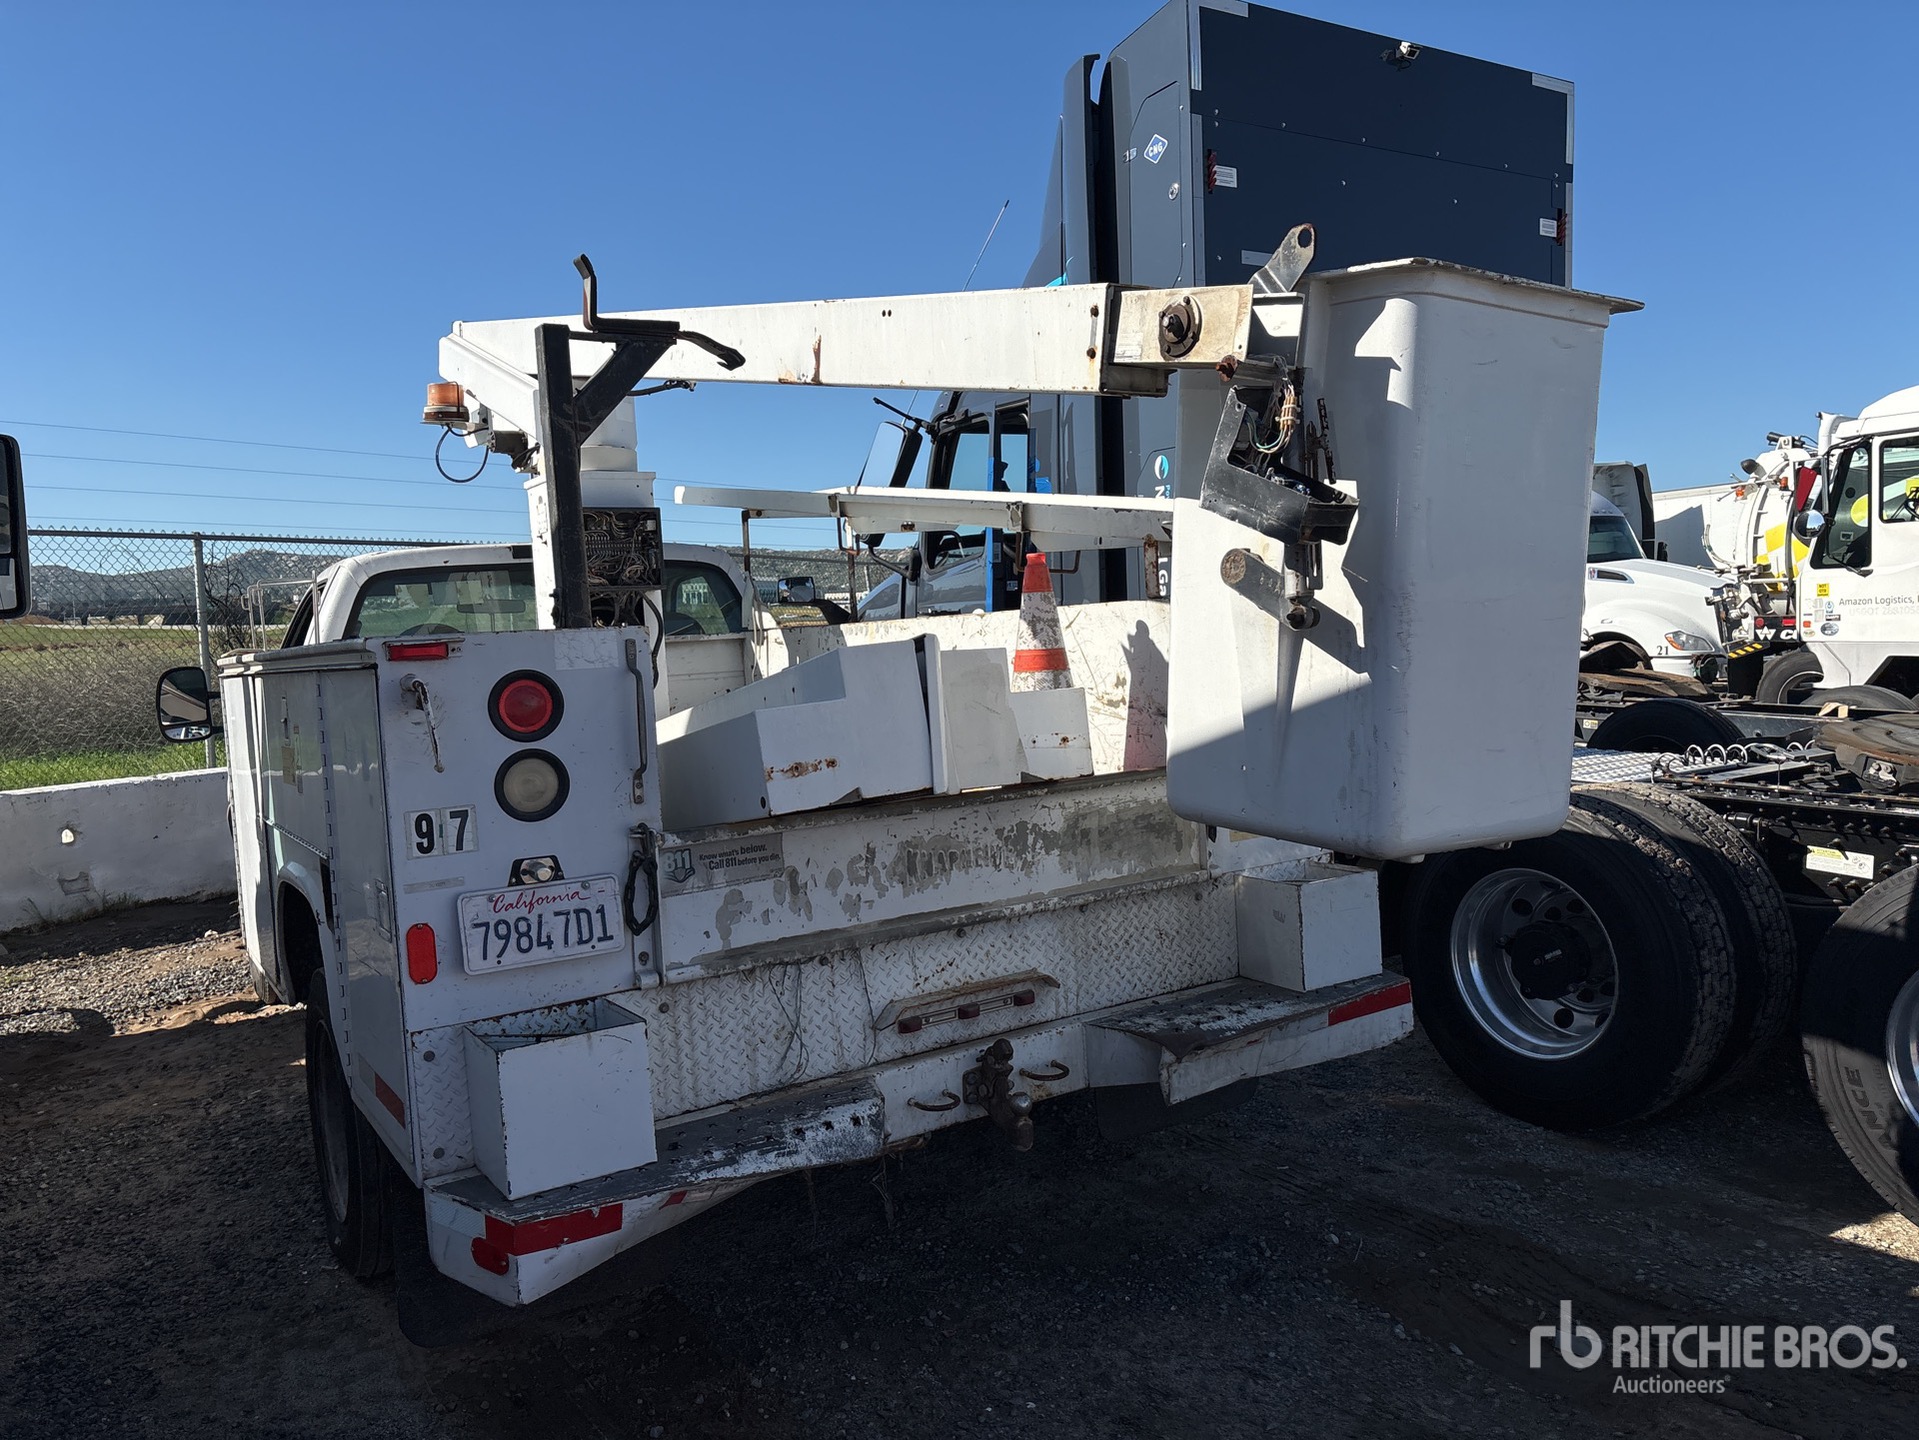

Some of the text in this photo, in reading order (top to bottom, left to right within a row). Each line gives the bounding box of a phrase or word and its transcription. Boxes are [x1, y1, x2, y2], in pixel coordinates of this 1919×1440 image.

[1149, 141, 1163, 157] CNG
[1839, 597, 1873, 606] Amazon
[1875, 594, 1915, 607] Logistics,
[1656, 645, 1669, 656] 21
[661, 848, 692, 872] 811
[699, 843, 768, 861] Know what's below.
[708, 859, 725, 871] Call
[725, 857, 737, 869] 811
[738, 856, 757, 866] before
[757, 855, 769, 865] you
[492, 889, 592, 915] California
[472, 904, 614, 961] 79847D1
